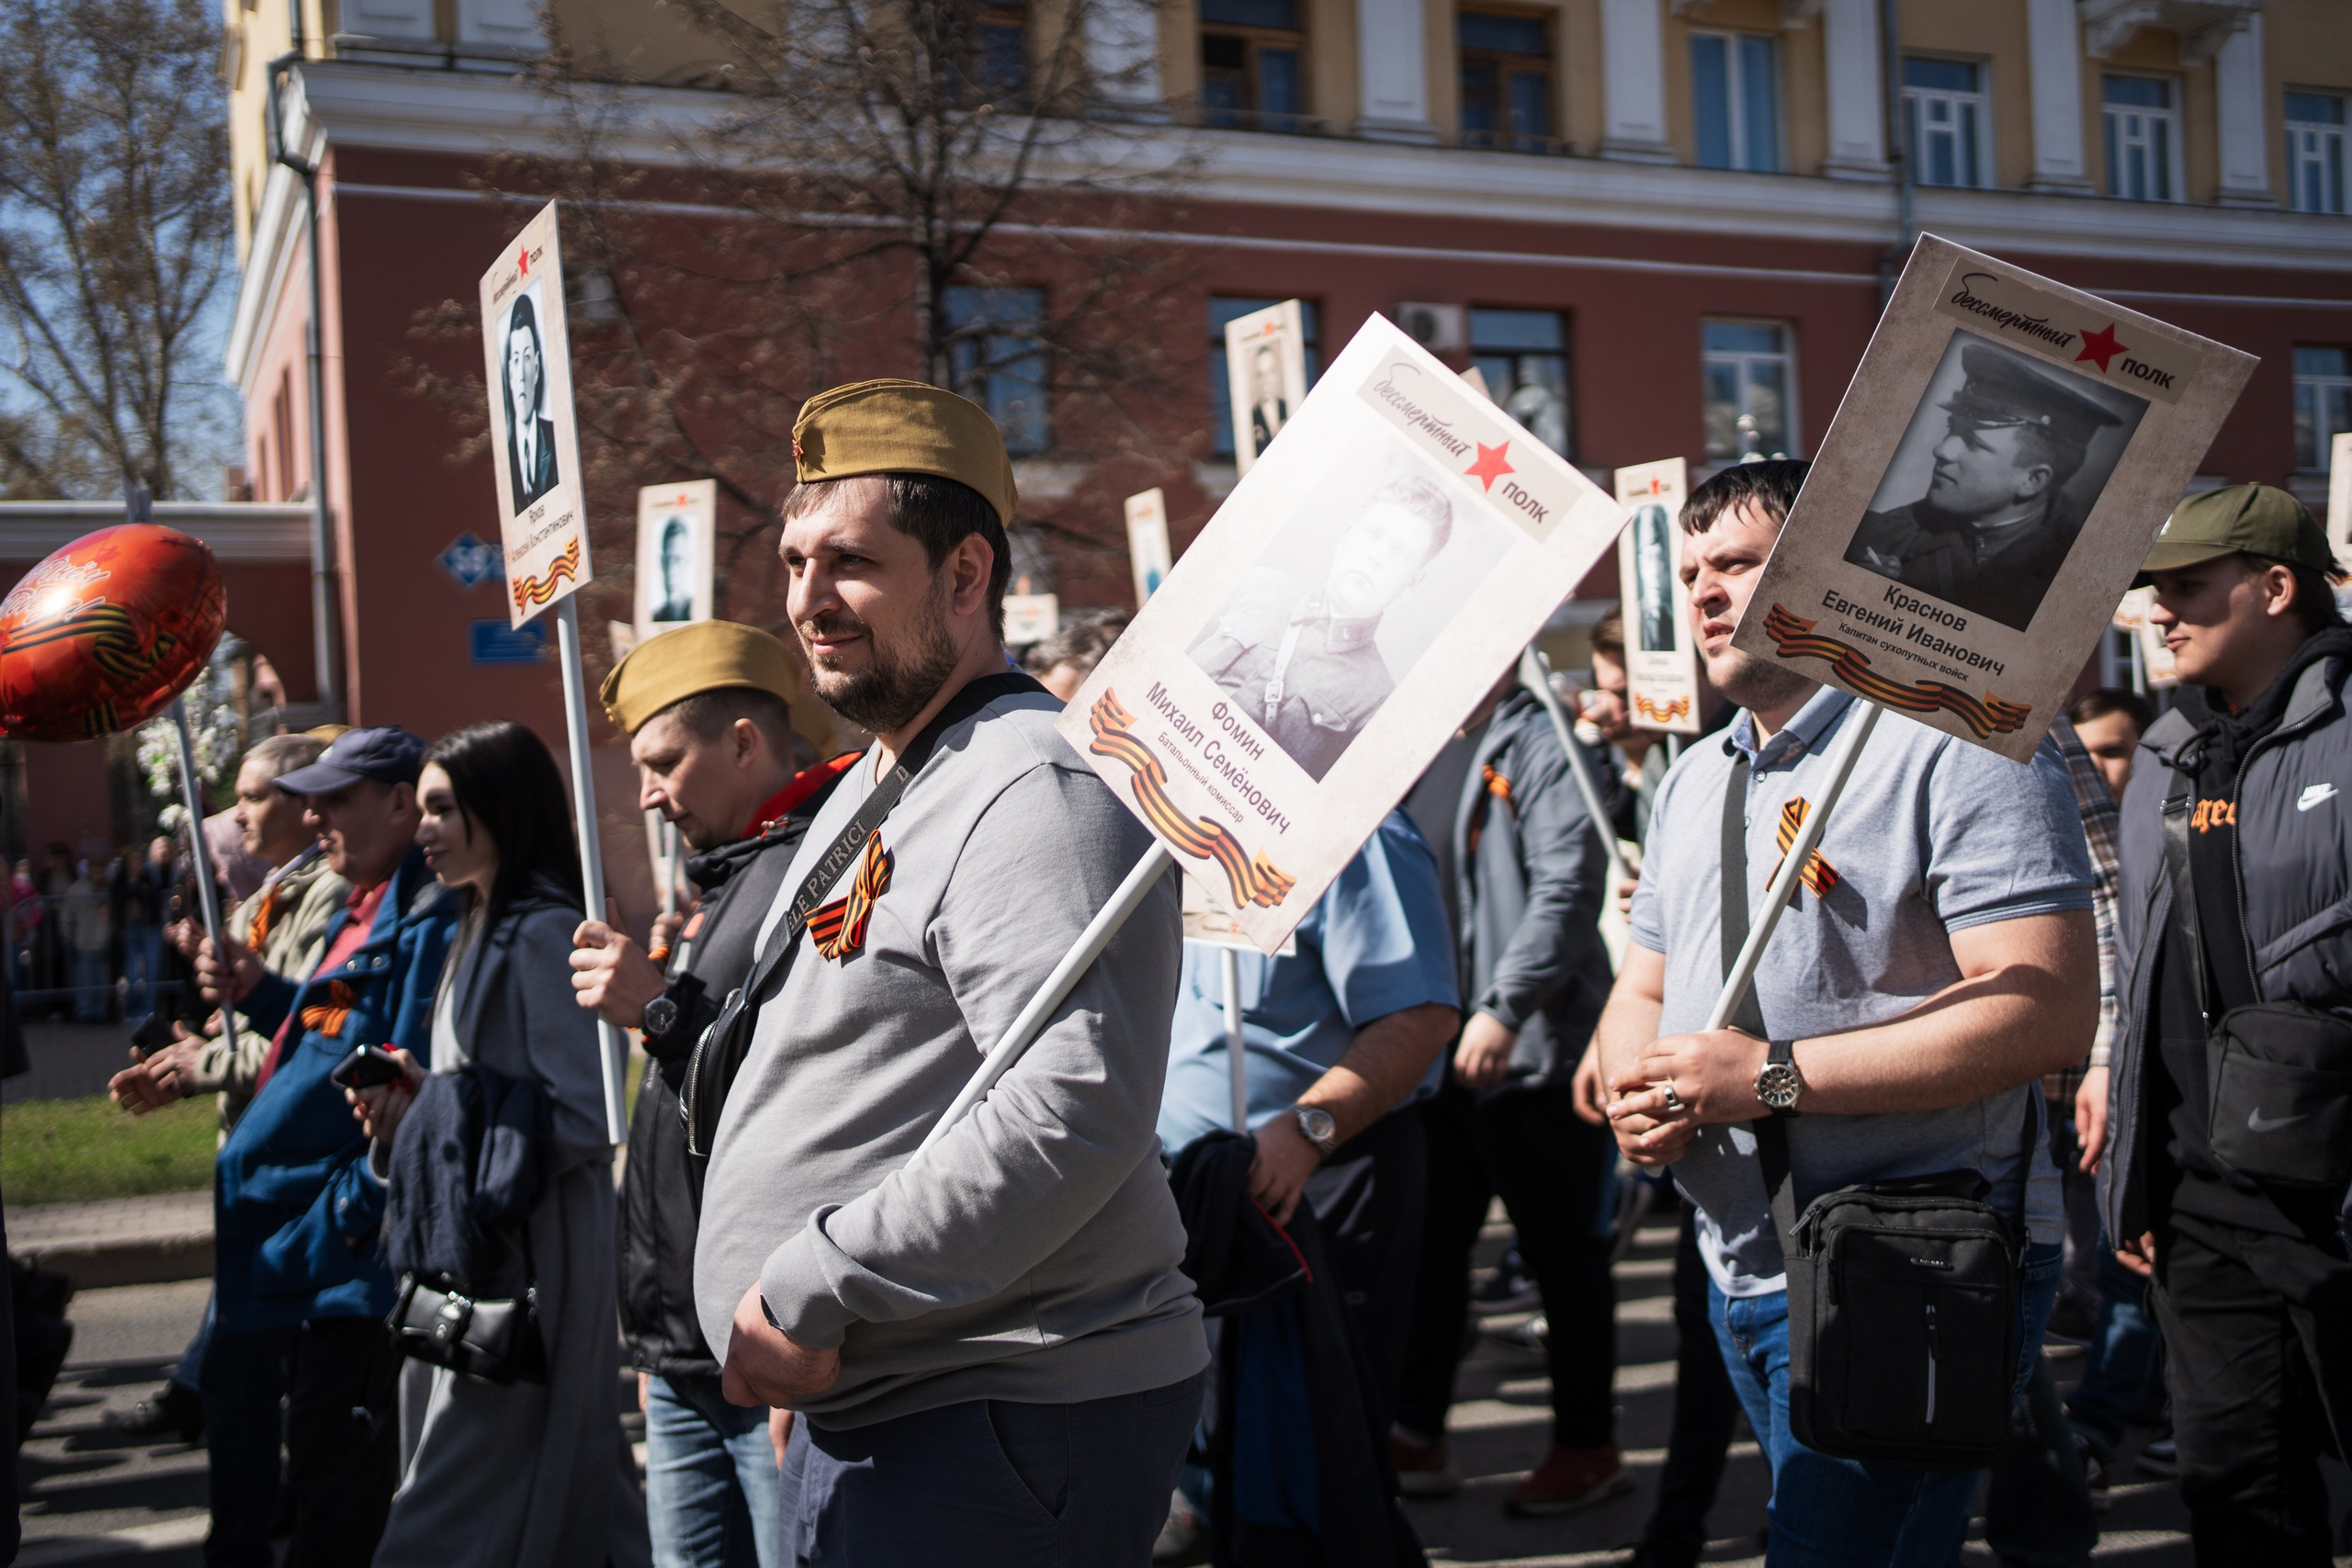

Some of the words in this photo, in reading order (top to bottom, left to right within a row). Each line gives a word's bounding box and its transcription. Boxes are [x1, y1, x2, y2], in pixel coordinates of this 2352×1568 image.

[1951, 272, 2076, 349] бессмертный
[1373, 362, 1472, 457] бессмертный
[1821, 589, 1905, 636] Евгений
[1905, 623, 2006, 676] Иванович
[1883, 584, 1967, 632] Краснов
[1838, 622, 1879, 646] Капитан
[1879, 640, 1939, 671] сухопутных
[1939, 664, 1970, 682] войск
[1146, 681, 1204, 748] Михаил
[1204, 740, 1291, 835] Семёнович
[1211, 701, 1265, 761] Фомин
[1158, 731, 1210, 787] Батальонный
[1206, 783, 1244, 823] комиссар
[807, 818, 867, 898] PATRICI
